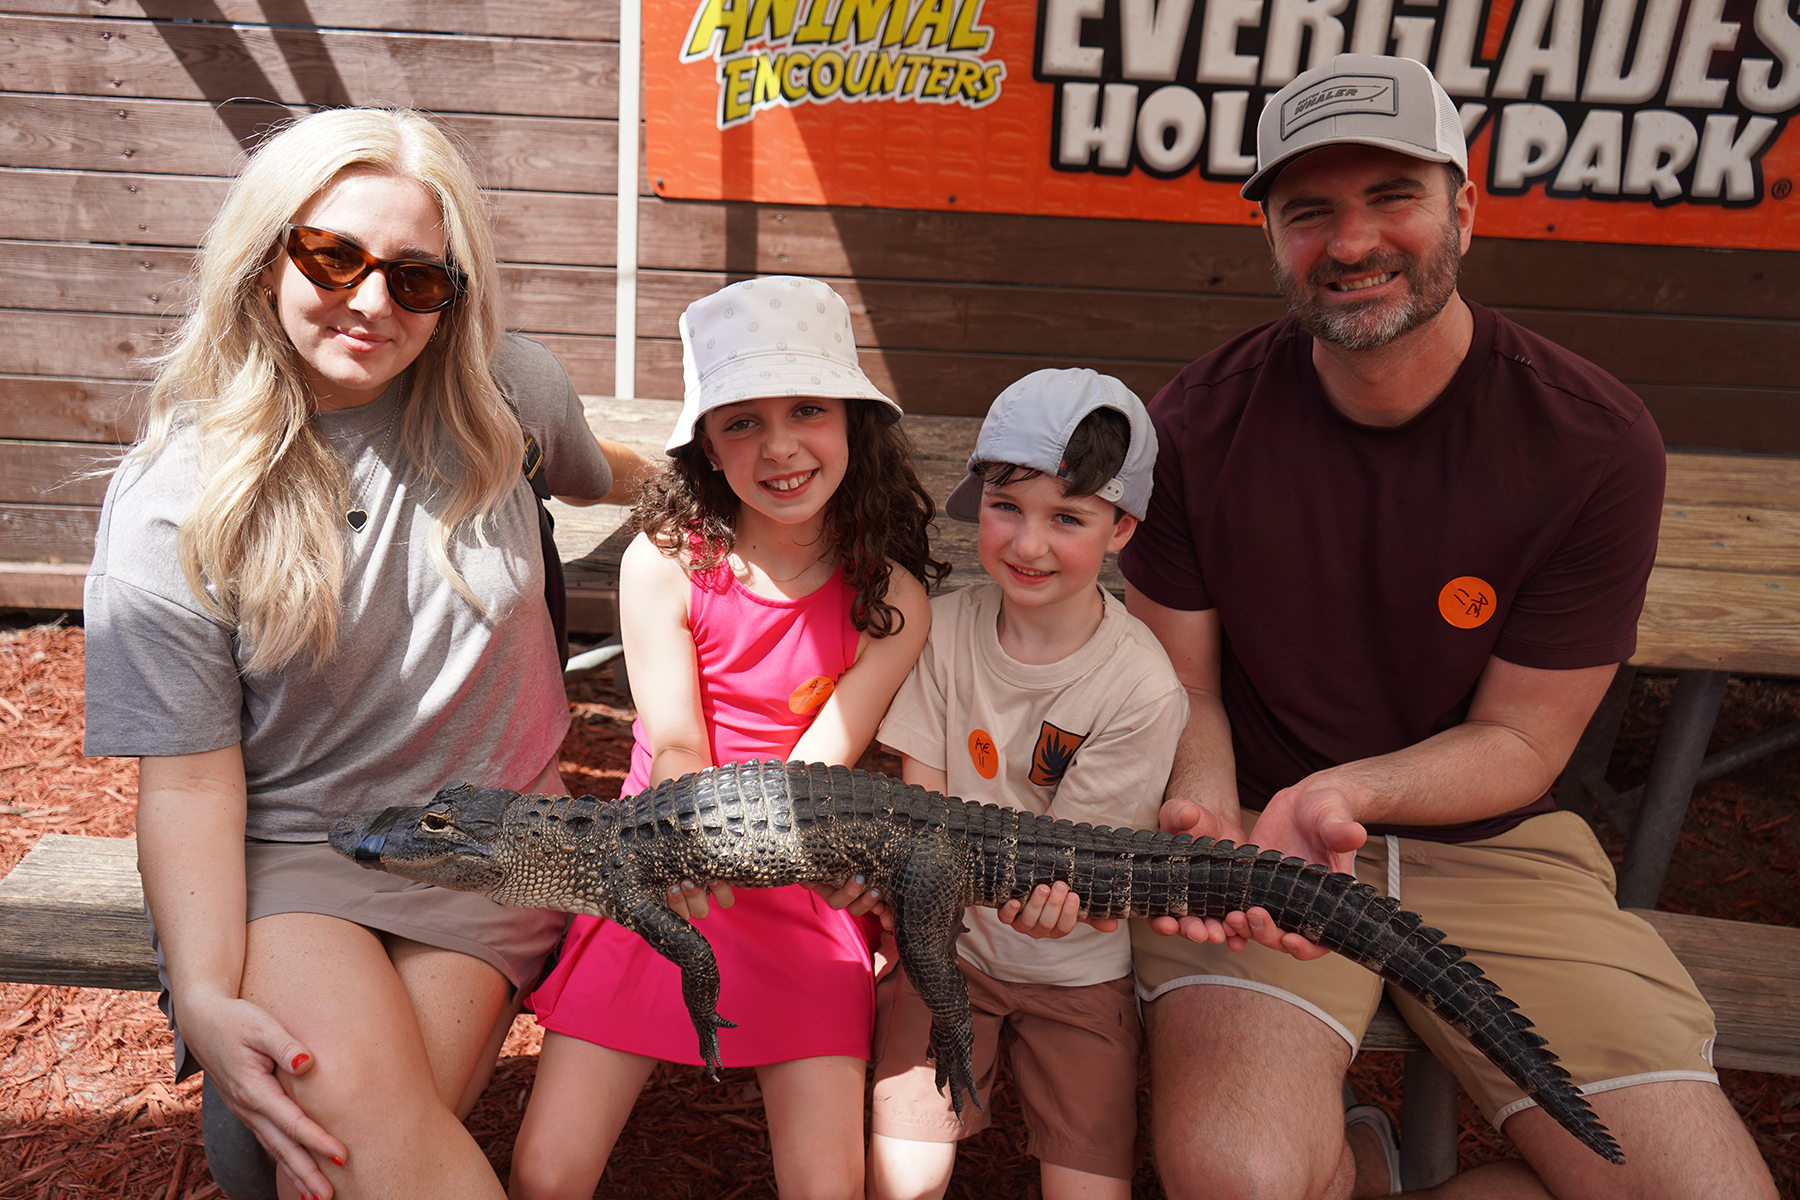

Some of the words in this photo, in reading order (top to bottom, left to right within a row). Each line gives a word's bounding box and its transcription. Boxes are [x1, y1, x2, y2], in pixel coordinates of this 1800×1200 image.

[684, 0, 991, 56] ANIMAL
[720, 51, 1003, 123] ENCOUNTERS
[1294, 88, 1358, 115] WHALER
[1493, 102, 1779, 201] PARK
